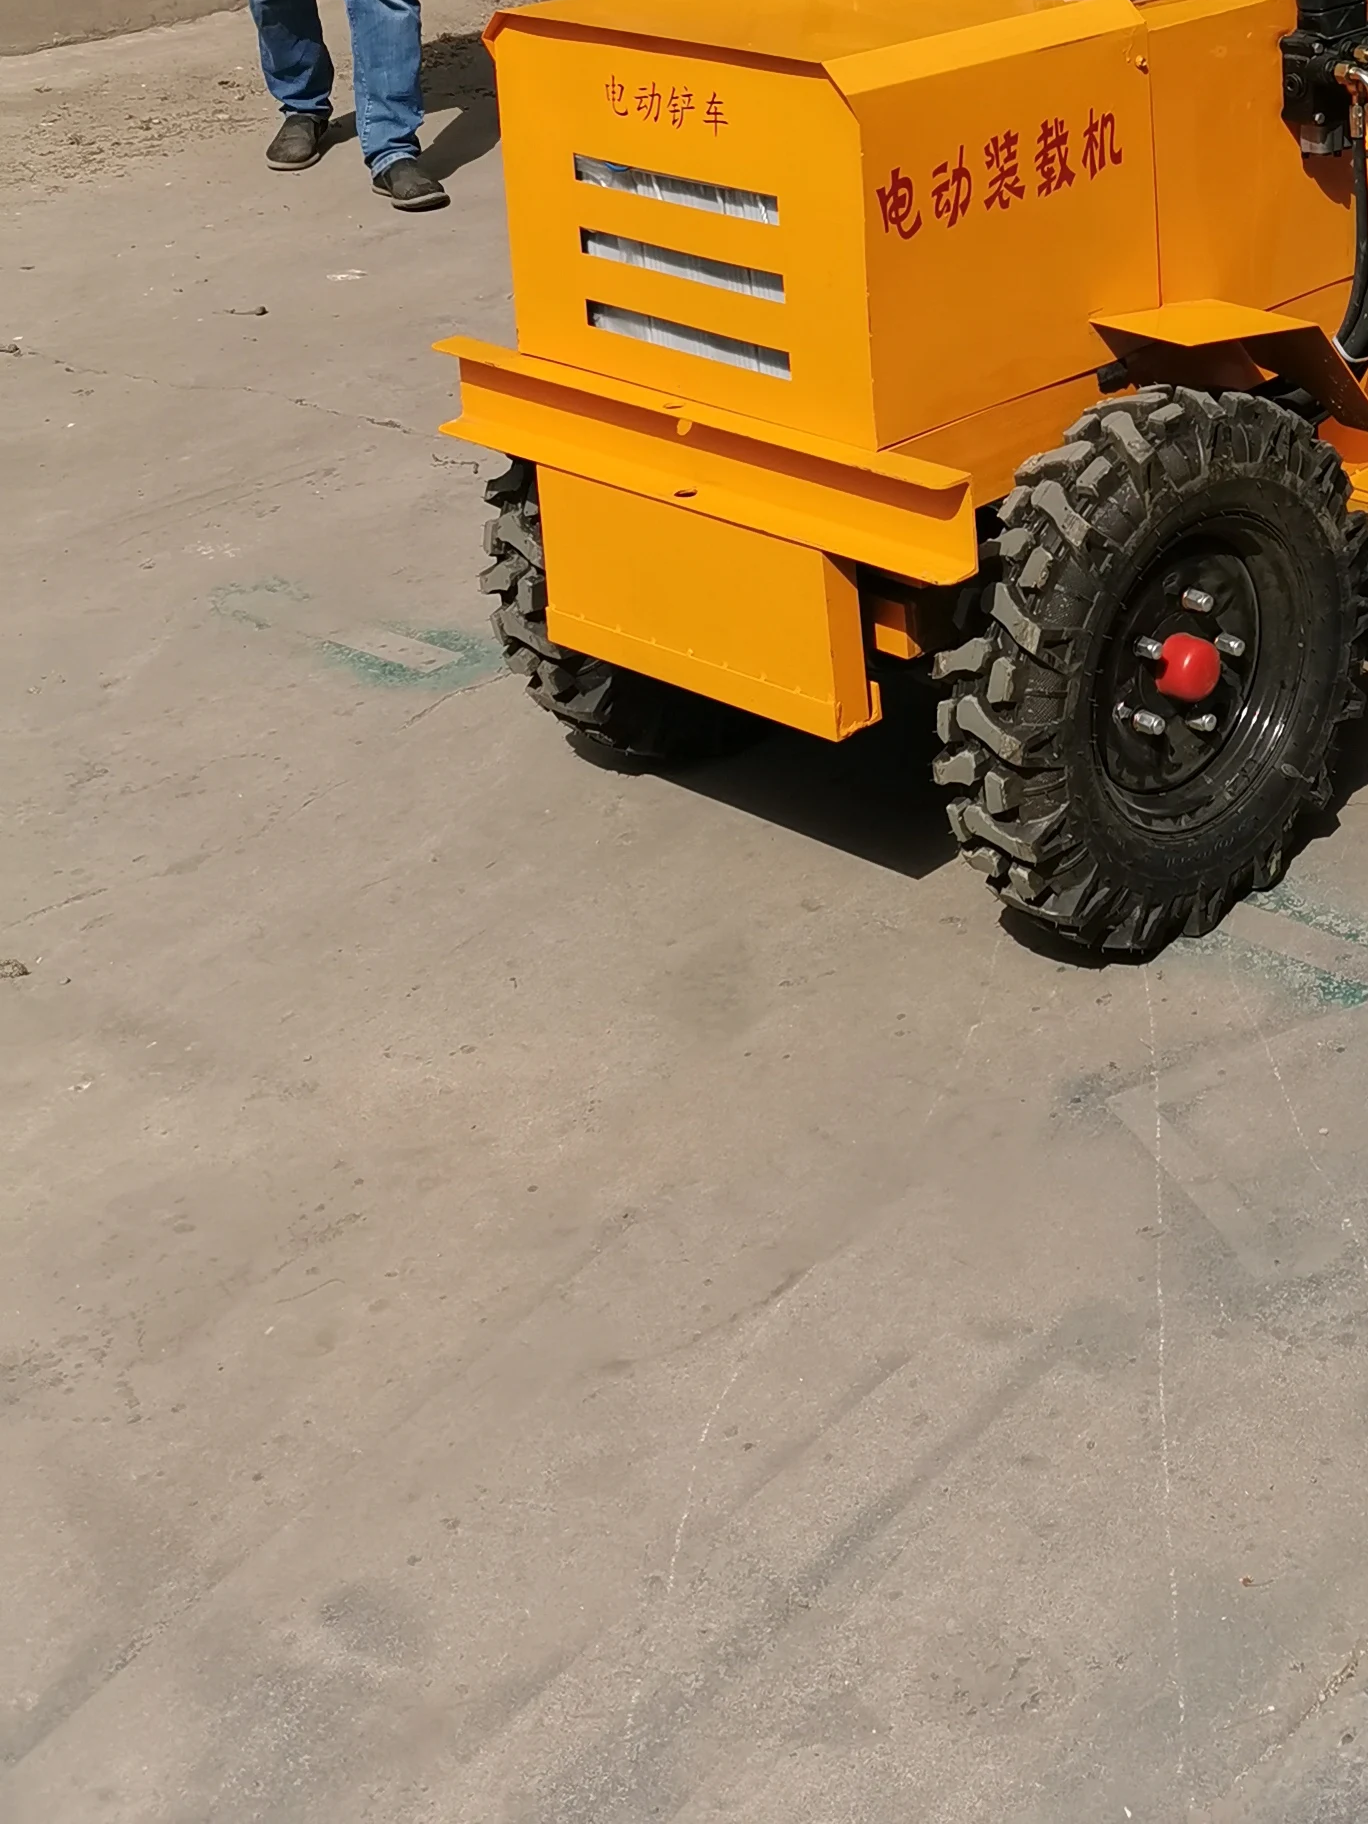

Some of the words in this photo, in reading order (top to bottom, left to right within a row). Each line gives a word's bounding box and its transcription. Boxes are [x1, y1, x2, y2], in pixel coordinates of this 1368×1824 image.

[605, 74, 729, 137] 电动铲车
[876, 107, 1123, 240] 电动装载机
